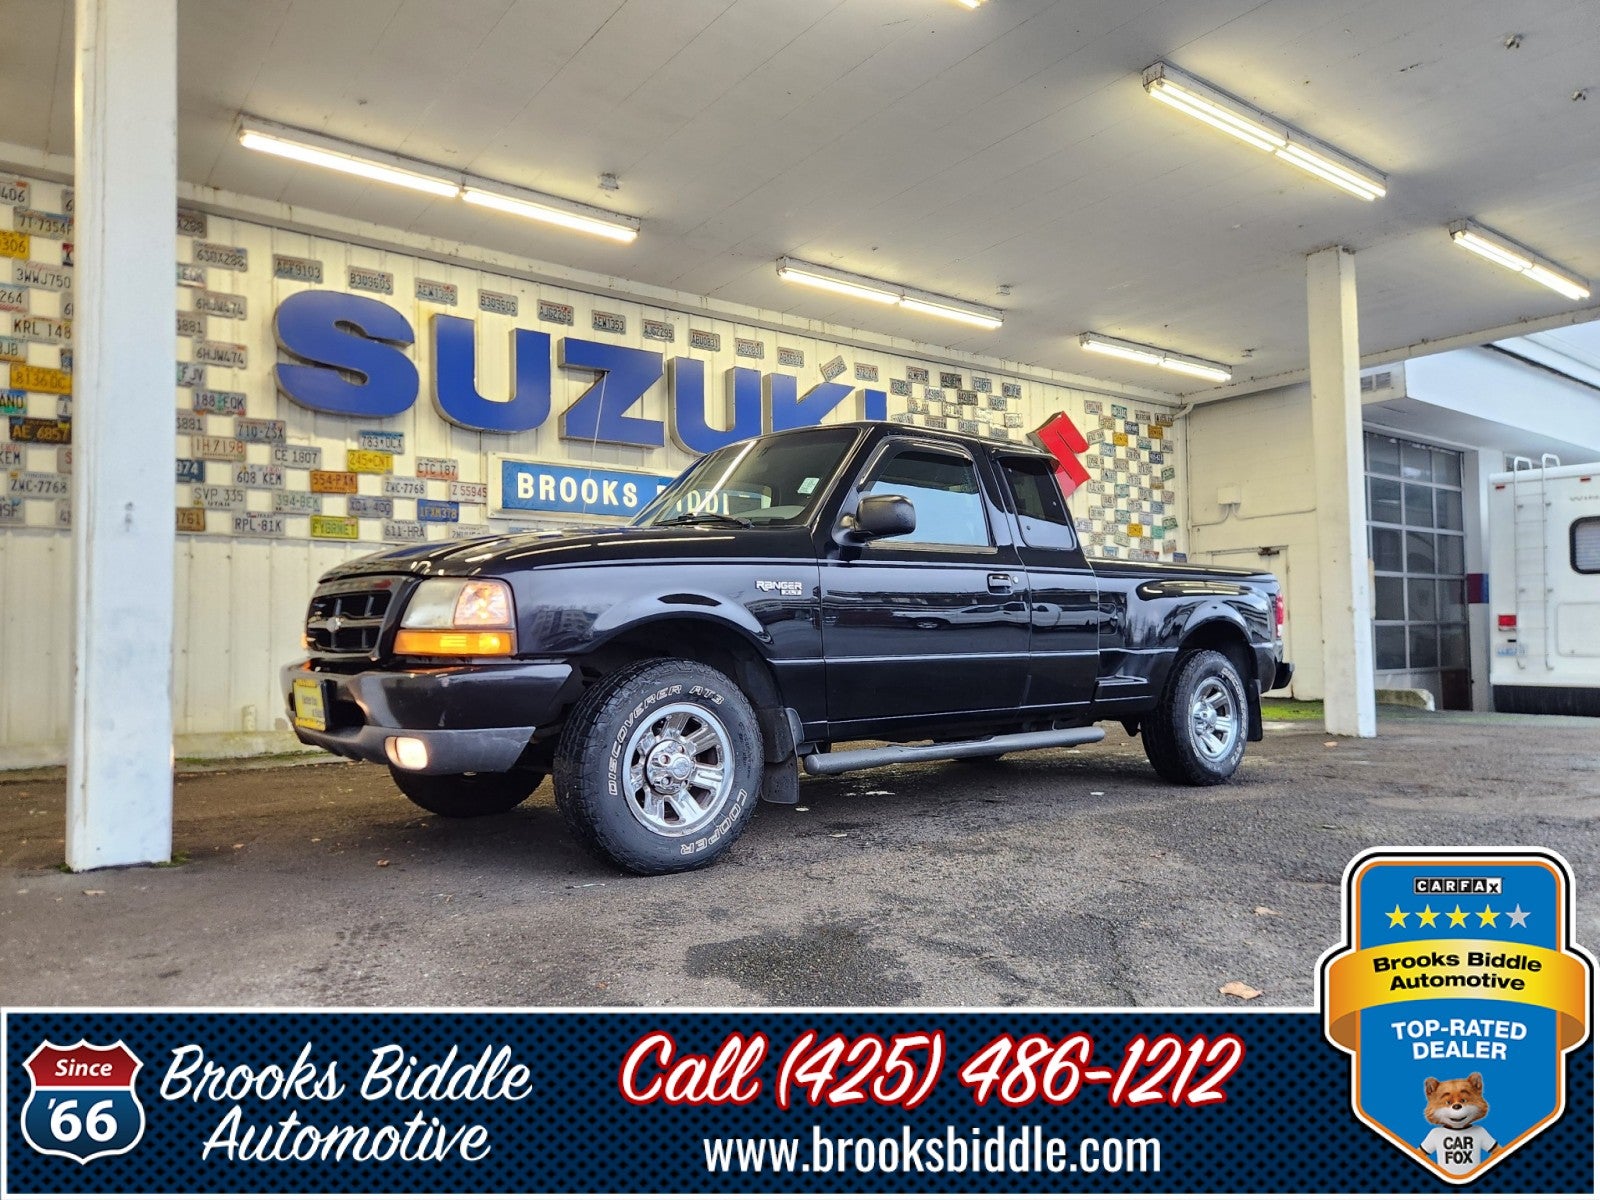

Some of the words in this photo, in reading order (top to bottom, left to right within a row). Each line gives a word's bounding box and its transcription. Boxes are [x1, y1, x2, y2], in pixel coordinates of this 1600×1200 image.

[16, 267, 71, 289] 3WWJ750
[13, 319, 40, 336] KRL
[47, 323, 72, 340] 148
[273, 290, 887, 456] SUZUK
[274, 448, 288, 461] CE
[237, 471, 257, 484] 608
[262, 471, 282, 486] KEM
[417, 462, 436, 475] CTC
[439, 464, 456, 477] 187
[10, 478, 67, 494] ZWC-7768
[194, 487, 218, 500] SVP
[224, 489, 243, 503] 335
[518, 471, 639, 509] BROOKS
[754, 580, 803, 593] RANGER
[608, 684, 683, 796] DISCOVERER
[689, 684, 725, 706] AT3
[680, 788, 748, 855] COOPER
